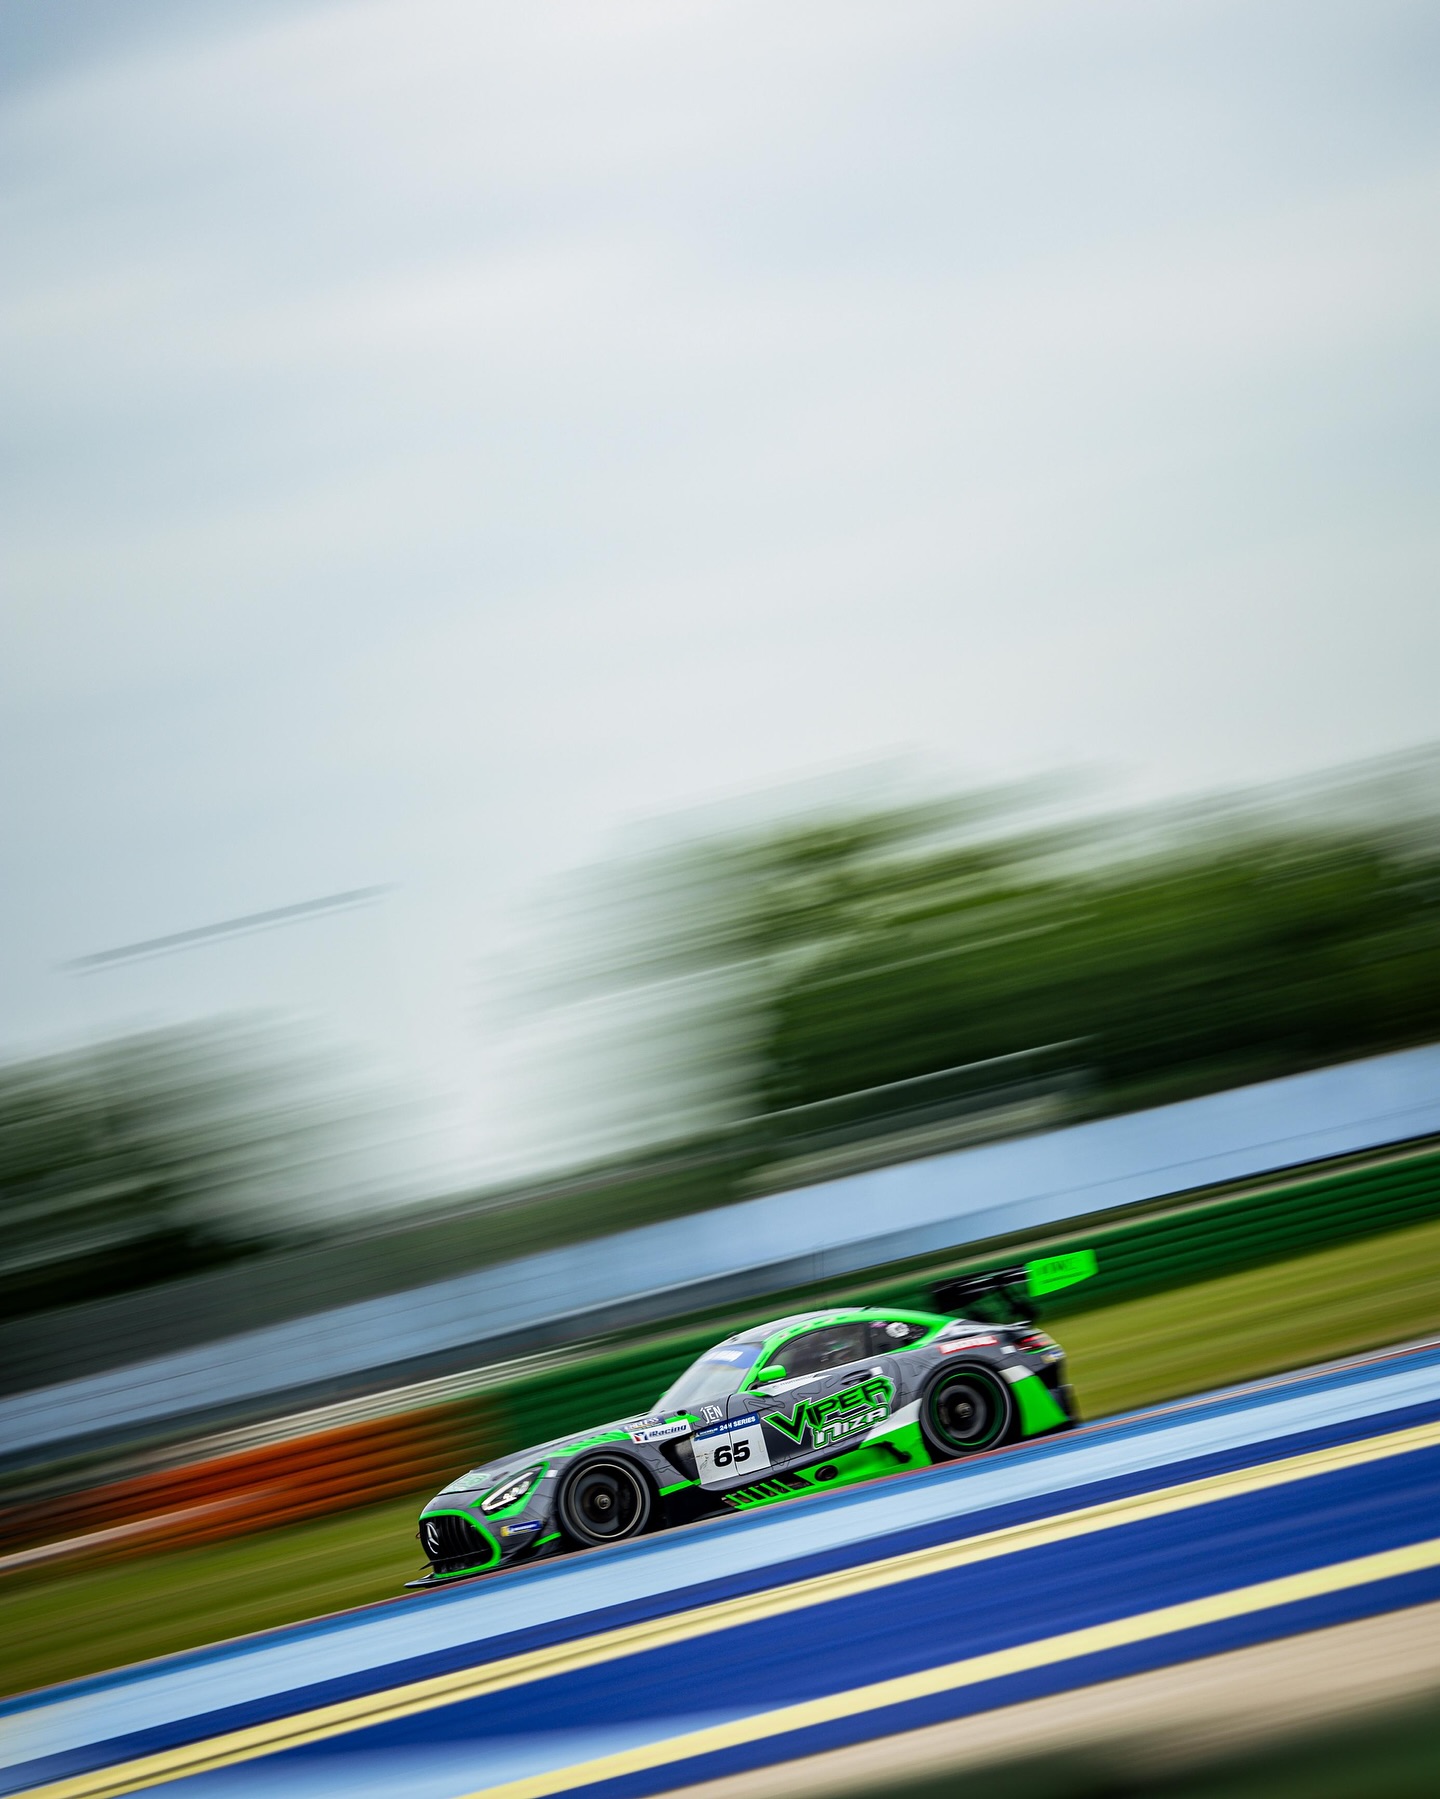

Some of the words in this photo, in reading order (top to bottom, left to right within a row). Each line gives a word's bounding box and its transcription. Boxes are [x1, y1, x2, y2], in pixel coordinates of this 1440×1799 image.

[700, 1405, 723, 1424] JEN
[763, 1375, 894, 1443] VIPER
[733, 1415, 756, 1427] SERIES
[648, 1424, 687, 1438] iRacing
[713, 1440, 751, 1467] 65
